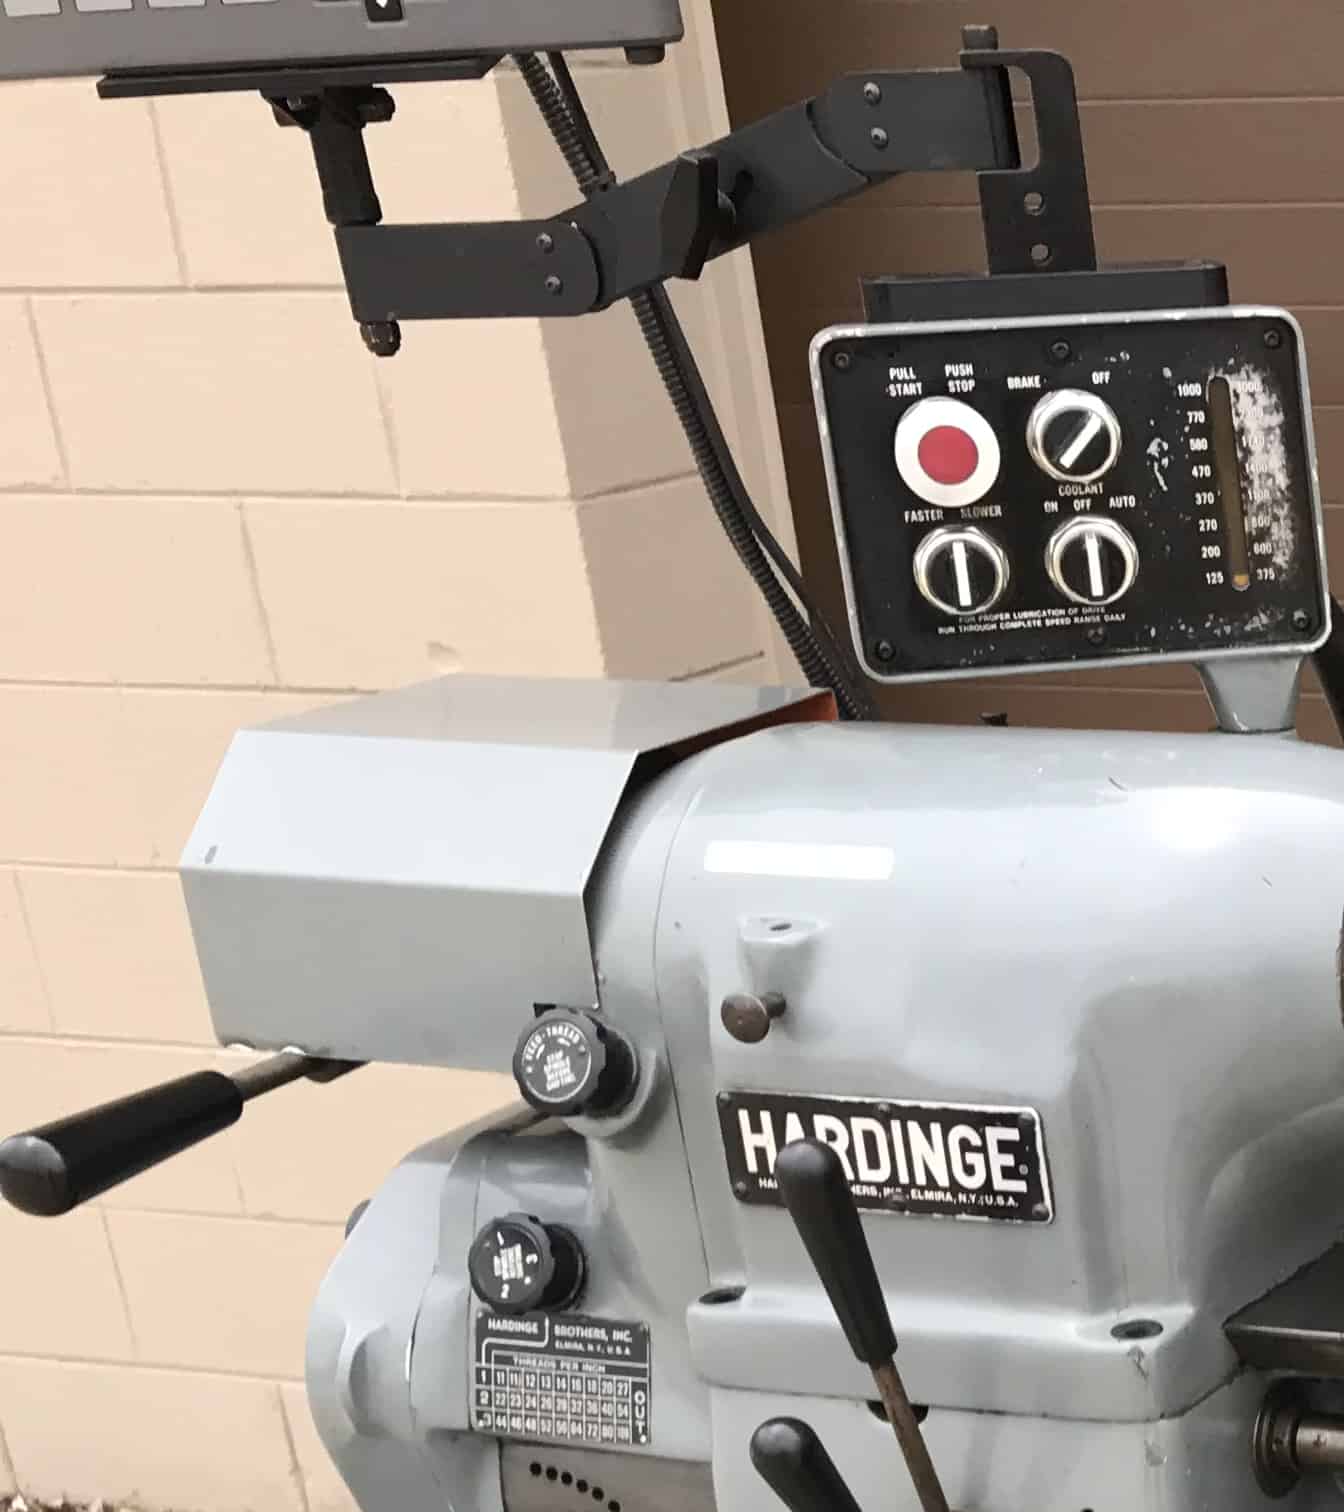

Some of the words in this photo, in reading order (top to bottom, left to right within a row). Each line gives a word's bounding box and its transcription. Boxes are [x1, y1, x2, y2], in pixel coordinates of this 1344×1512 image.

[889, 367, 916, 380] PULL
[944, 364, 974, 377] PUSH
[1091, 371, 1111, 384] OFF
[947, 379, 975, 393] STOP
[1007, 375, 1041, 389] BRAKE
[888, 382, 923, 397] START
[1177, 383, 1202, 397] 1000
[1187, 410, 1205, 424] 770
[1191, 465, 1211, 478] 470
[1058, 482, 1104, 497] COOLANT
[1073, 498, 1092, 512] OFF
[1109, 495, 1136, 509] AUTO
[1195, 492, 1215, 505] 370
[960, 505, 1002, 519] SLOWER
[1044, 500, 1059, 513] ON
[903, 508, 944, 523] FASTER
[1199, 519, 1218, 532] 270
[1201, 545, 1221, 558] 200
[1206, 572, 1224, 585] 125
[1256, 568, 1275, 581] 375
[1013, 609, 1066, 620] LUBRICATION
[1000, 620, 1042, 631] COMPLETE
[1045, 617, 1072, 627] SPEED
[1104, 613, 1126, 622] DAILY
[487, 1317, 538, 1335] HARDINGE
